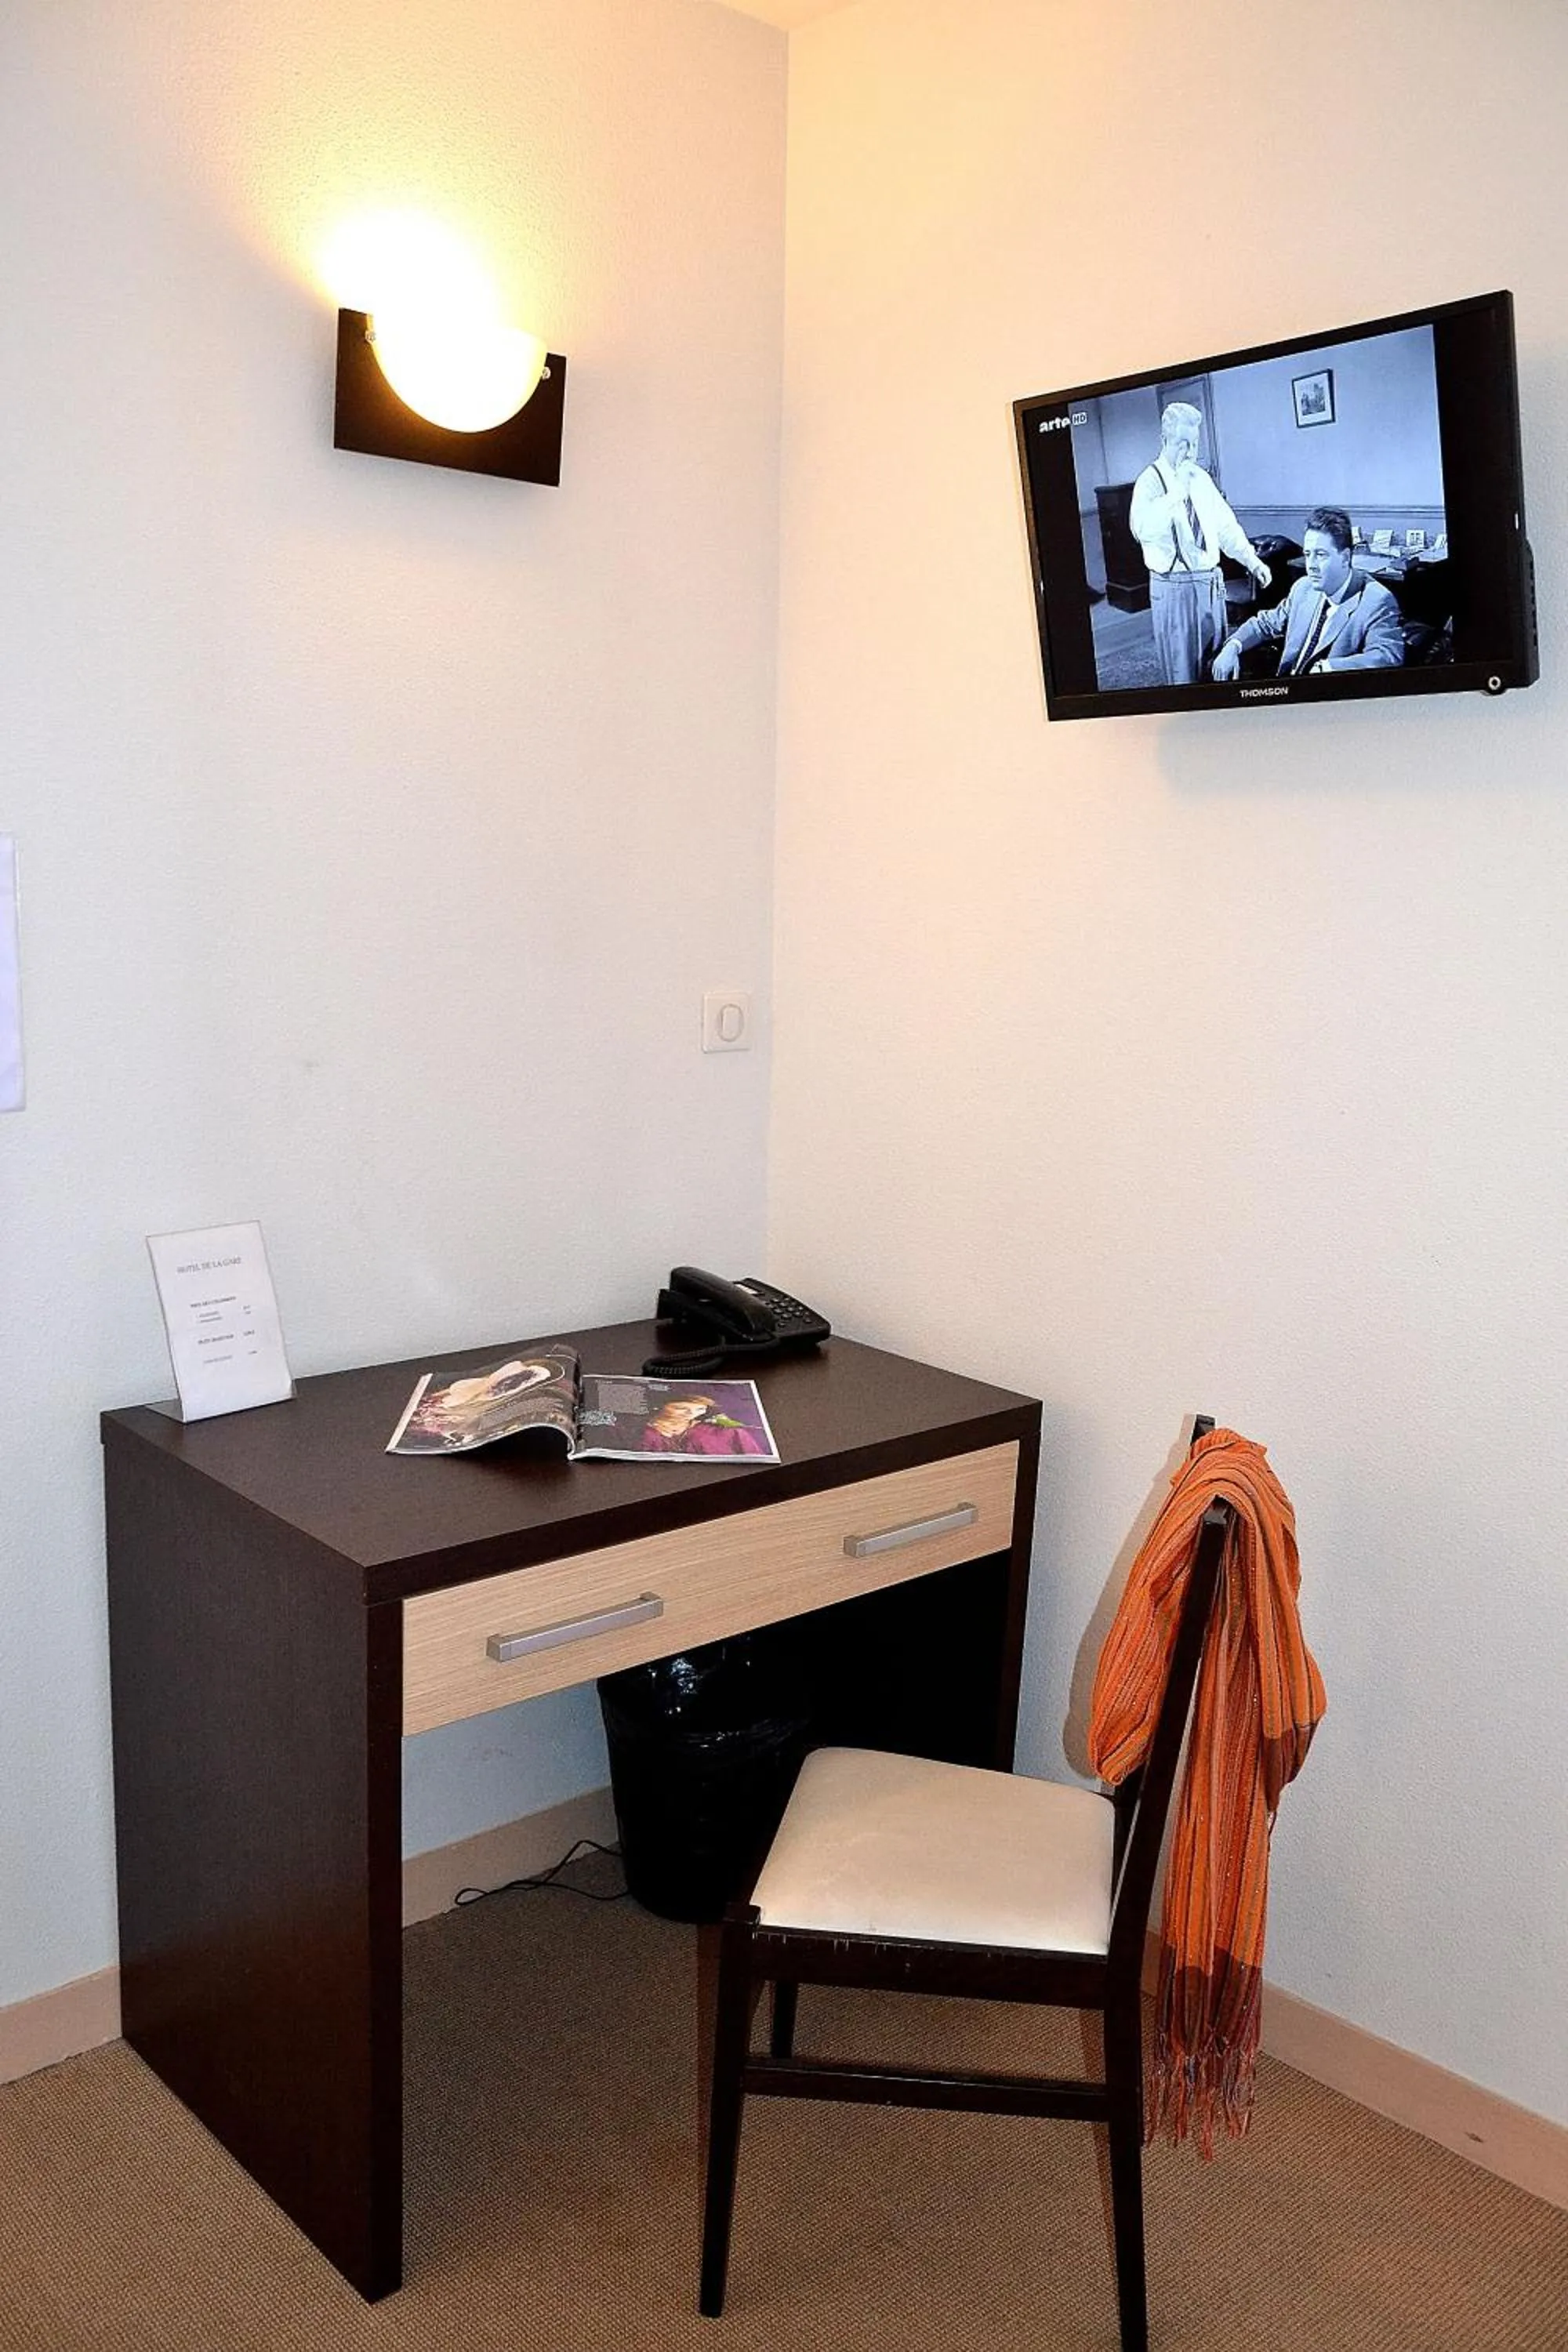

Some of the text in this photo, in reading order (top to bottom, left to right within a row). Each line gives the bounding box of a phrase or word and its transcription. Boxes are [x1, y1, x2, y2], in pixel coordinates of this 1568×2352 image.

[1039, 412, 1087, 433] arte HD
[1240, 686, 1289, 698] THOMSON
